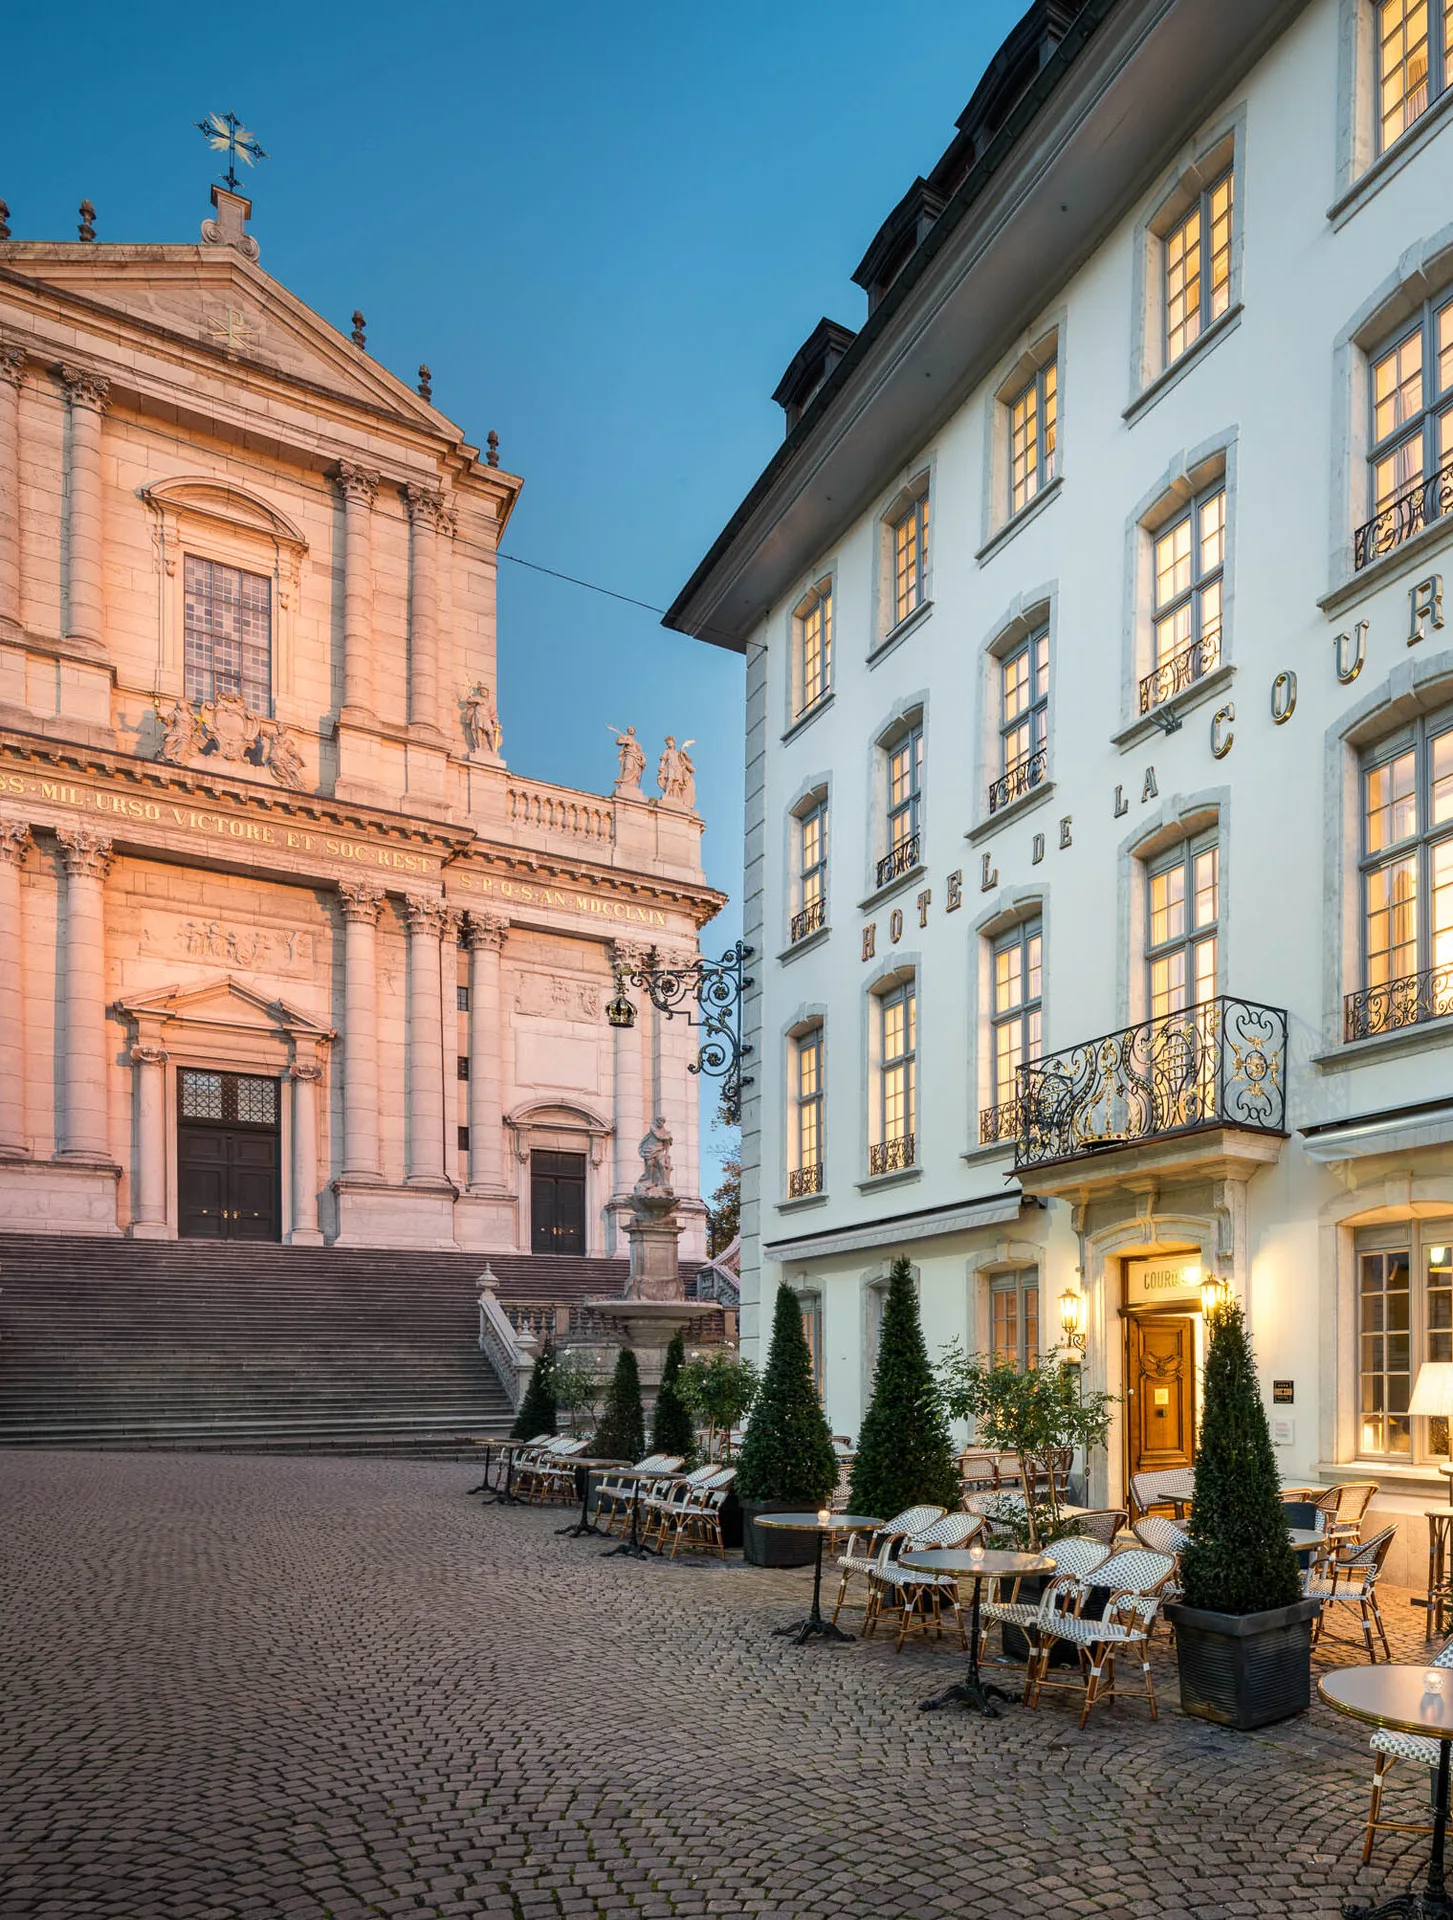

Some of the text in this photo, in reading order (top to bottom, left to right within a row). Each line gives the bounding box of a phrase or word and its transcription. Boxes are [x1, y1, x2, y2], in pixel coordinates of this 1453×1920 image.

[96, 793, 161, 821] URSO
[172, 808, 275, 844] VICTORE
[286, 831, 315, 851] ET
[861, 851, 998, 962] HOTEL
[1032, 814, 1072, 866] DE
[1113, 766, 1159, 819] LA
